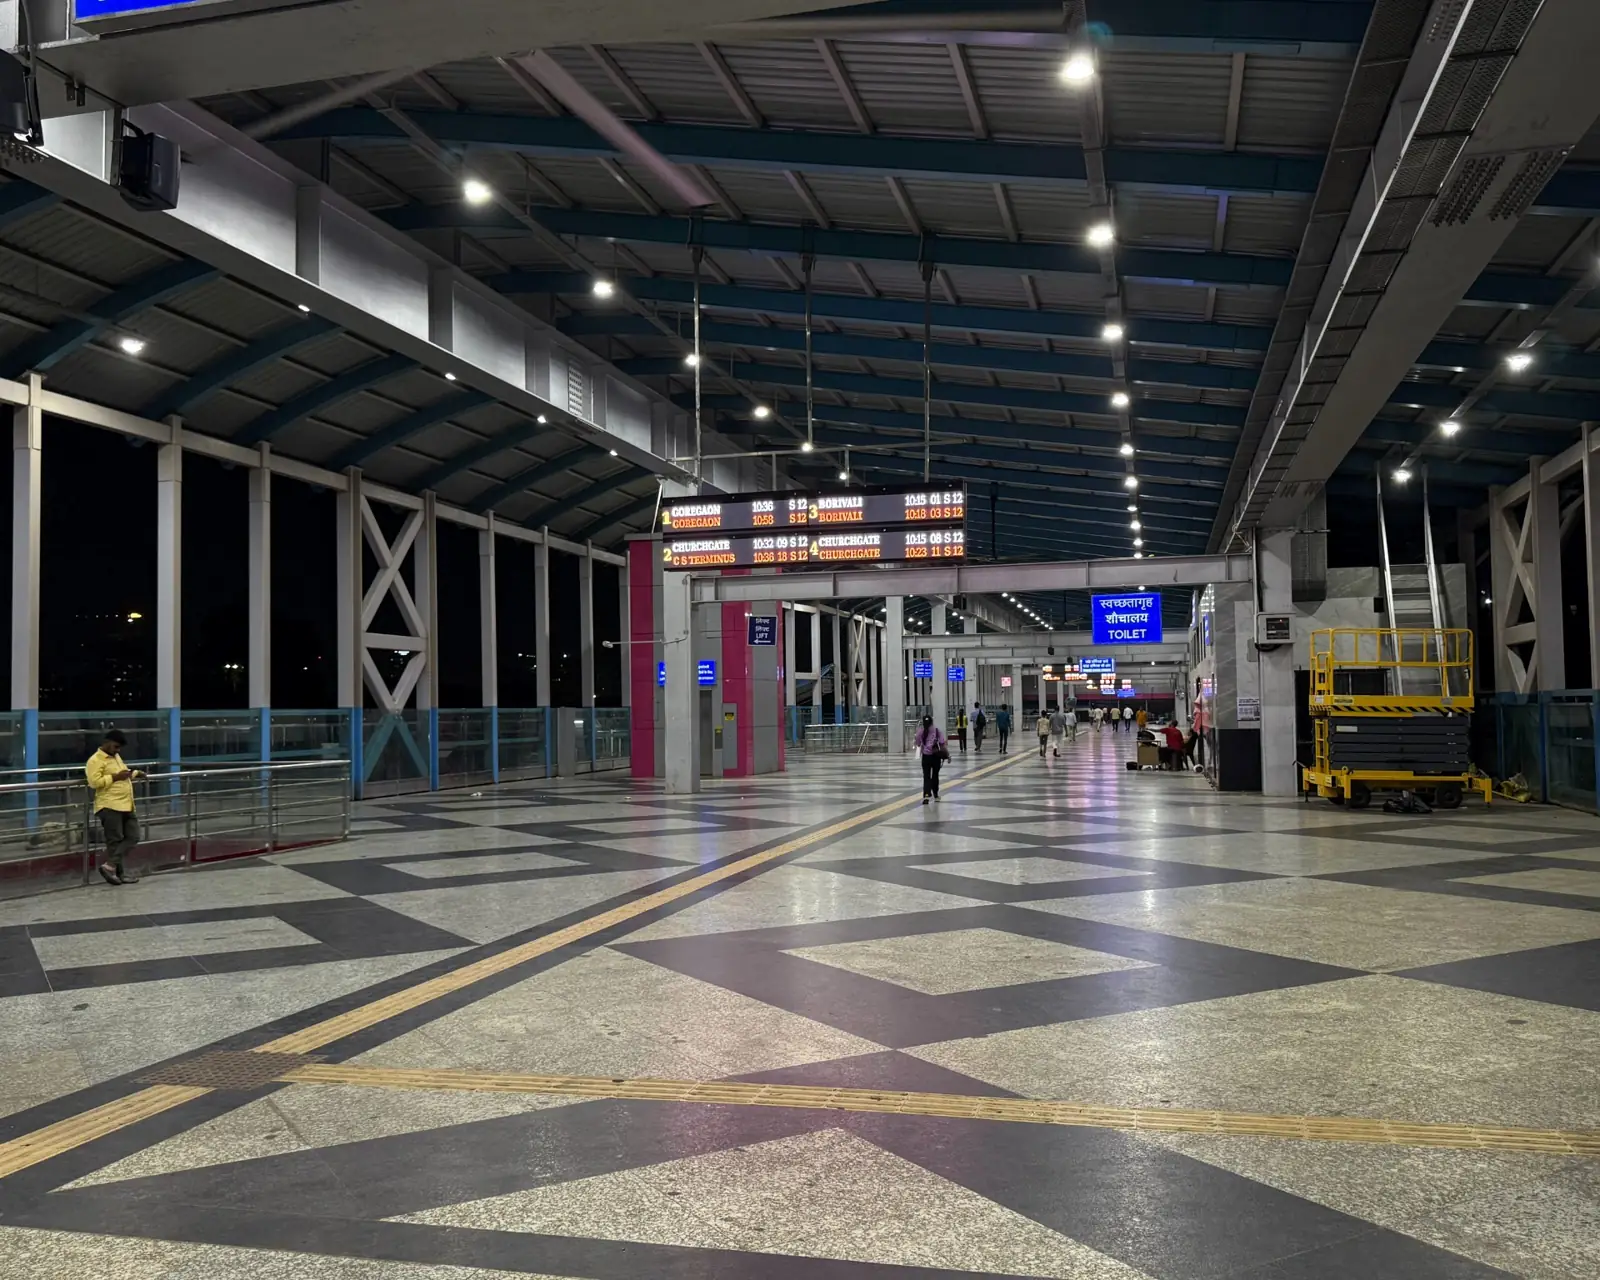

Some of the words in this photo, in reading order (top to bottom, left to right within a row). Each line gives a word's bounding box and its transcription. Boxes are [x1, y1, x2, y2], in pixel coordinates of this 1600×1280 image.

[672, 504, 721, 517] GOREGAON
[752, 501, 774, 513] 10:36
[789, 499, 796, 510] S
[797, 499, 807, 510] 12
[818, 496, 863, 509] BORIVALI
[905, 494, 926, 506] 10:15
[930, 493, 941, 505] 01
[944, 493, 951, 504] S
[952, 492, 963, 504] 12
[662, 511, 672, 525] 1
[808, 505, 818, 518] 3
[818, 510, 863, 523] BORIVALI
[905, 508, 926, 521] 10:18
[930, 508, 941, 519] 03
[944, 508, 951, 518] S
[952, 507, 963, 518] 12
[673, 516, 721, 529] GOREGAON
[753, 514, 774, 526] 10:58
[790, 513, 796, 524] S
[797, 513, 807, 524] 12
[672, 540, 731, 553] CHURCHGATE
[753, 538, 774, 550] 10:32
[777, 537, 788, 549] 09
[790, 537, 797, 548] S
[798, 536, 808, 547] 12
[818, 535, 880, 547] CHURCHGATE
[905, 533, 927, 545] 10:15
[930, 533, 941, 544] 08
[945, 533, 951, 543] S
[953, 532, 963, 543] 12
[663, 548, 673, 561] 2
[809, 540, 819, 556] 4
[819, 548, 880, 560] CHURCHGATE
[905, 547, 927, 558] 10:23
[931, 546, 941, 557] 11
[944, 546, 951, 557] S
[953, 545, 963, 556] 12
[673, 556, 680, 566] C
[681, 555, 688, 566] S
[689, 553, 736, 565] TERMINUS
[753, 551, 774, 563] 10:36
[778, 551, 788, 562] 18
[790, 551, 797, 561] S
[798, 550, 808, 561] 12
[1099, 598, 1154, 610] स्वच्छतागृह
[1105, 611, 1149, 624] शौचालय
[1108, 629, 1147, 640] TOILET
